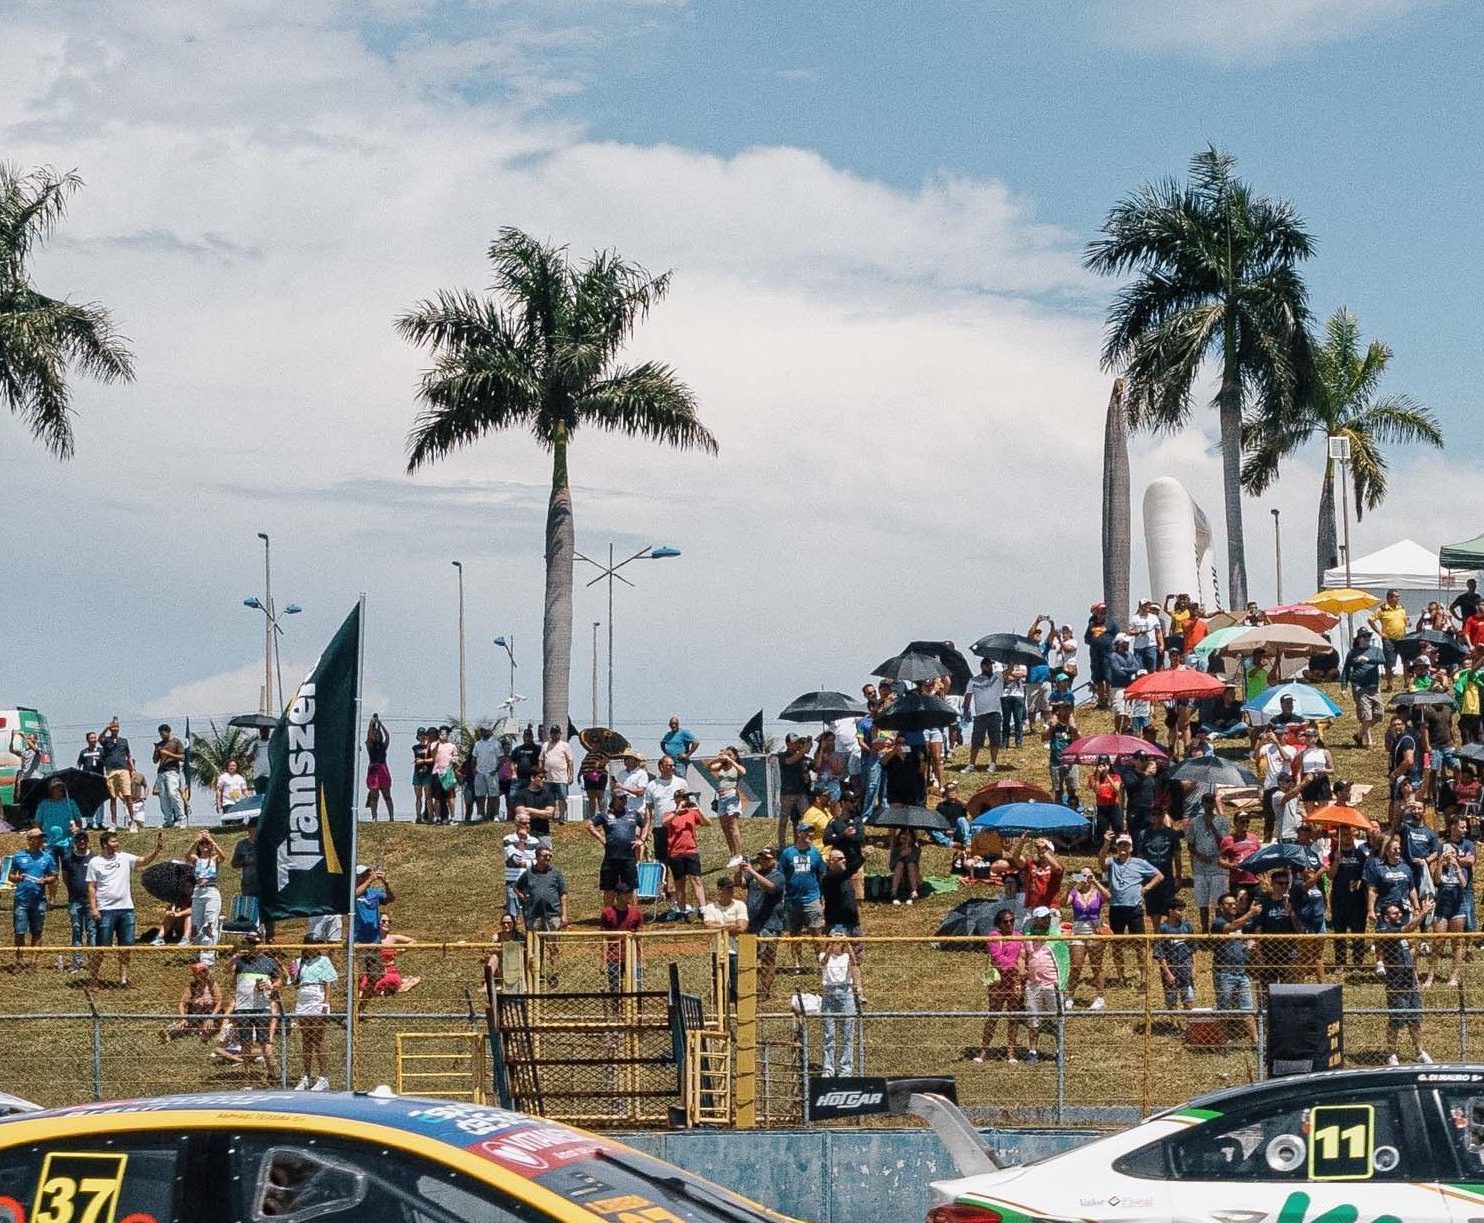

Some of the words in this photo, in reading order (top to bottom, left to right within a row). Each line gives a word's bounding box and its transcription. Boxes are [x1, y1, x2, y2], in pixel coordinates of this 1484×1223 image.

[277, 655, 324, 892] Transzer
[816, 1090, 884, 1109] HOTCAR
[1314, 1125, 1369, 1160] 11
